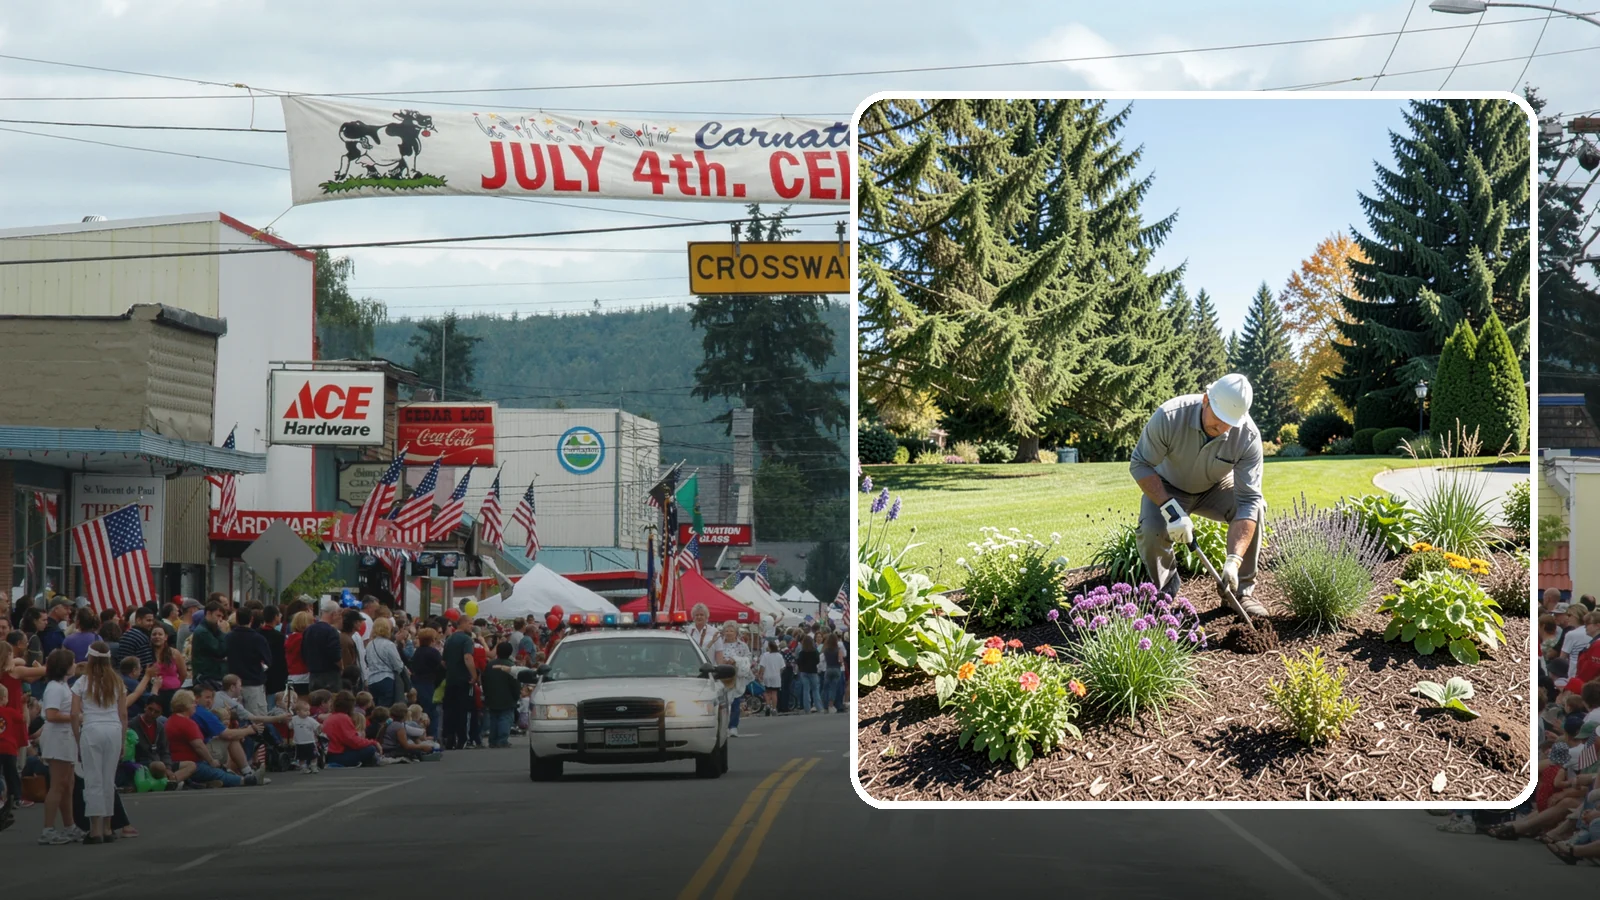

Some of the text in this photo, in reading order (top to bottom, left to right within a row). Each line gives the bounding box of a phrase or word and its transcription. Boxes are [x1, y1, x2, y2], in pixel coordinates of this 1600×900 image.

[695, 121, 850, 149] Carnat
[481, 141, 605, 192] JULY
[632, 150, 746, 197] 4th.
[697, 254, 850, 280] CROSSWA
[283, 380, 373, 420] ACE
[405, 409, 452, 422] CEDAR
[283, 421, 371, 436] Hardware
[353, 467, 386, 480] Simpl
[95, 485, 124, 495] Vincent
[126, 486, 136, 494] de
[138, 486, 155, 495] Paul
[688, 526, 741, 535] CRNATION
[699, 535, 730, 543] GLASS
